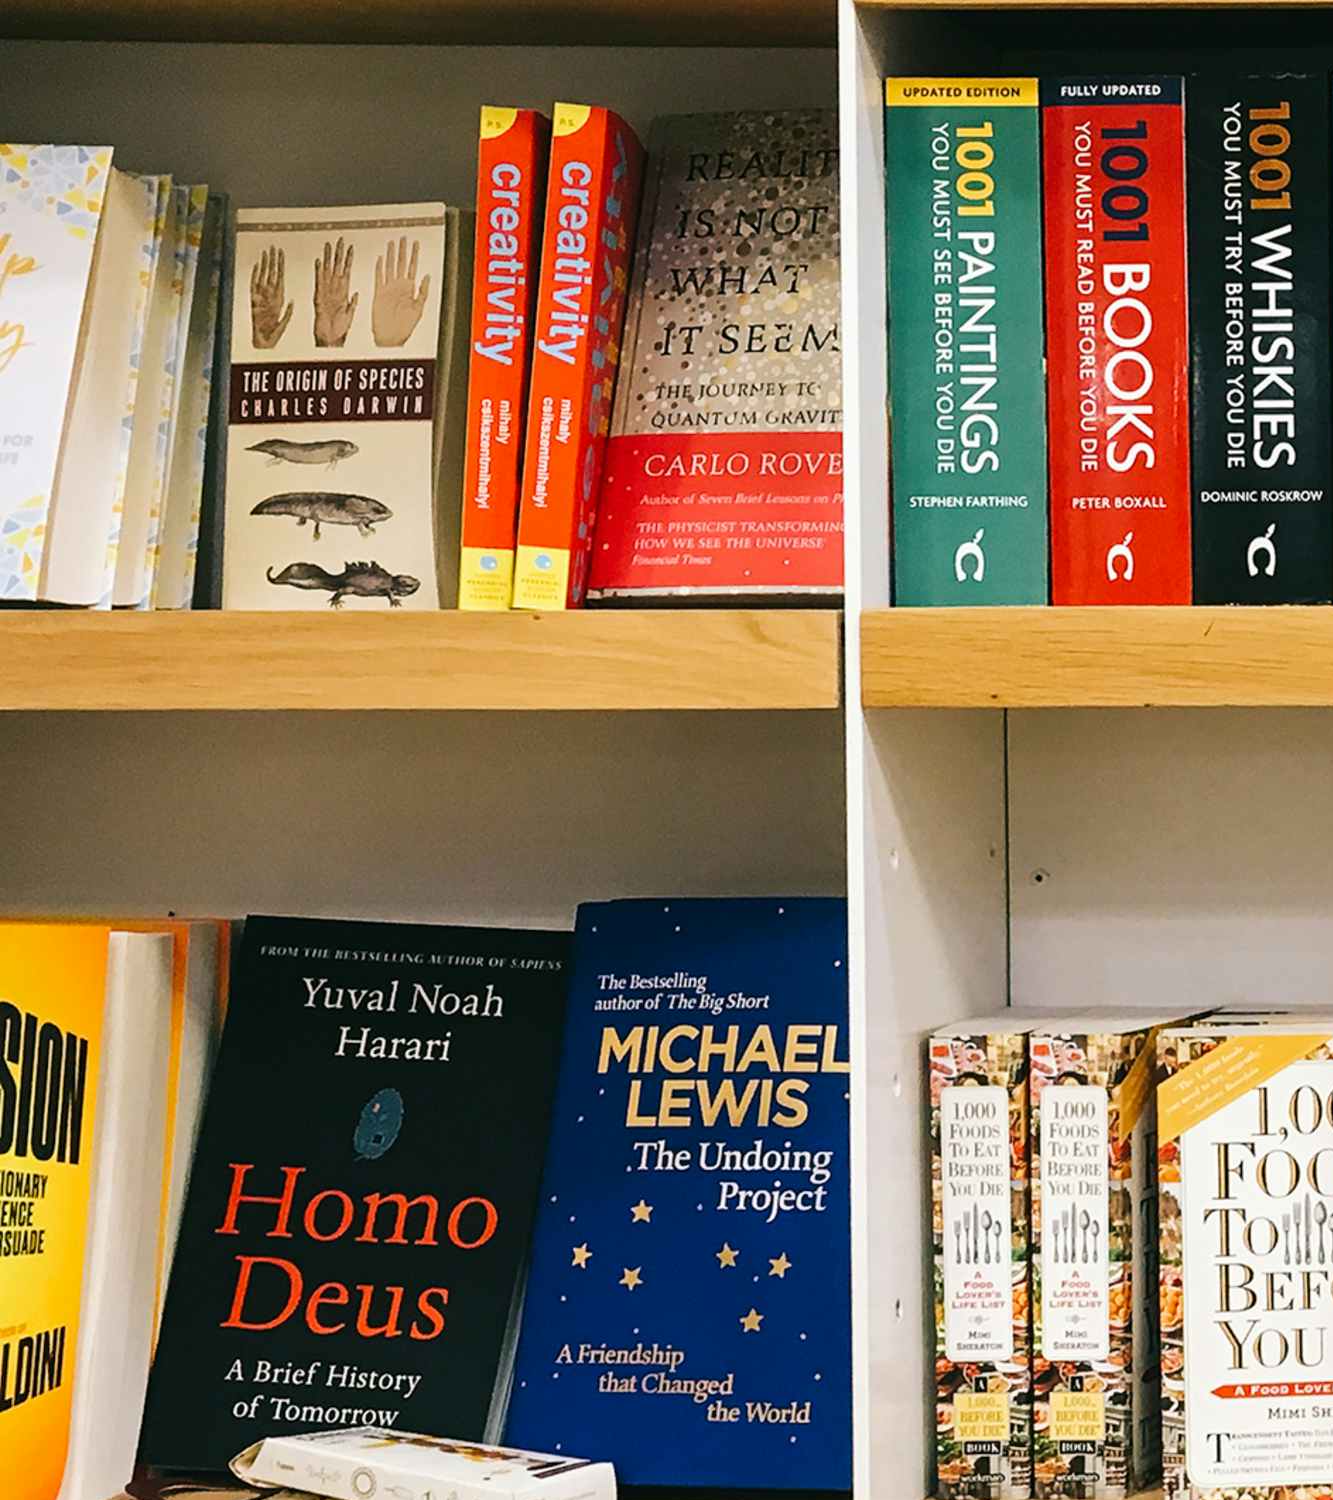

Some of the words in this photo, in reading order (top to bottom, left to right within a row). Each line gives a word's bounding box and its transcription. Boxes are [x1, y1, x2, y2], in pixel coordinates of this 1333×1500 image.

[903, 87, 962, 97] UPDATED
[966, 87, 1021, 97] EDITION
[956, 122, 995, 216] 1001
[1248, 102, 1292, 209] 1001
[1101, 120, 1150, 242] 1001
[474, 163, 524, 366] creativity
[540, 160, 592, 366] creativity
[958, 232, 999, 475] PAINTINGS
[1103, 263, 1156, 472] BOOKS
[1251, 224, 1295, 468] WHISKIES
[242, 370, 271, 393] THE
[275, 368, 328, 393] ORIGIN
[333, 367, 353, 390] OF
[358, 366, 425, 390] SPECIES
[240, 398, 329, 418] CHARLES
[343, 396, 423, 416] DARWIN
[909, 496, 963, 508] STEPHEN
[966, 496, 1028, 508] FARTHING
[1072, 497, 1109, 509] PETER
[1113, 497, 1167, 509] BOXALL
[302, 978, 400, 1013] Yuval
[408, 983, 505, 1018] Noah
[334, 1025, 452, 1062] Harari
[598, 1024, 849, 1073] MICHAEL
[625, 1081, 810, 1128] LEWIS
[215, 1164, 499, 1249] Homo
[1204, 1208, 1279, 1258] TO
[219, 1256, 450, 1340] Deus
[1213, 1321, 1324, 1369] YOU
[1268, 1407, 1306, 1419] MIMI
